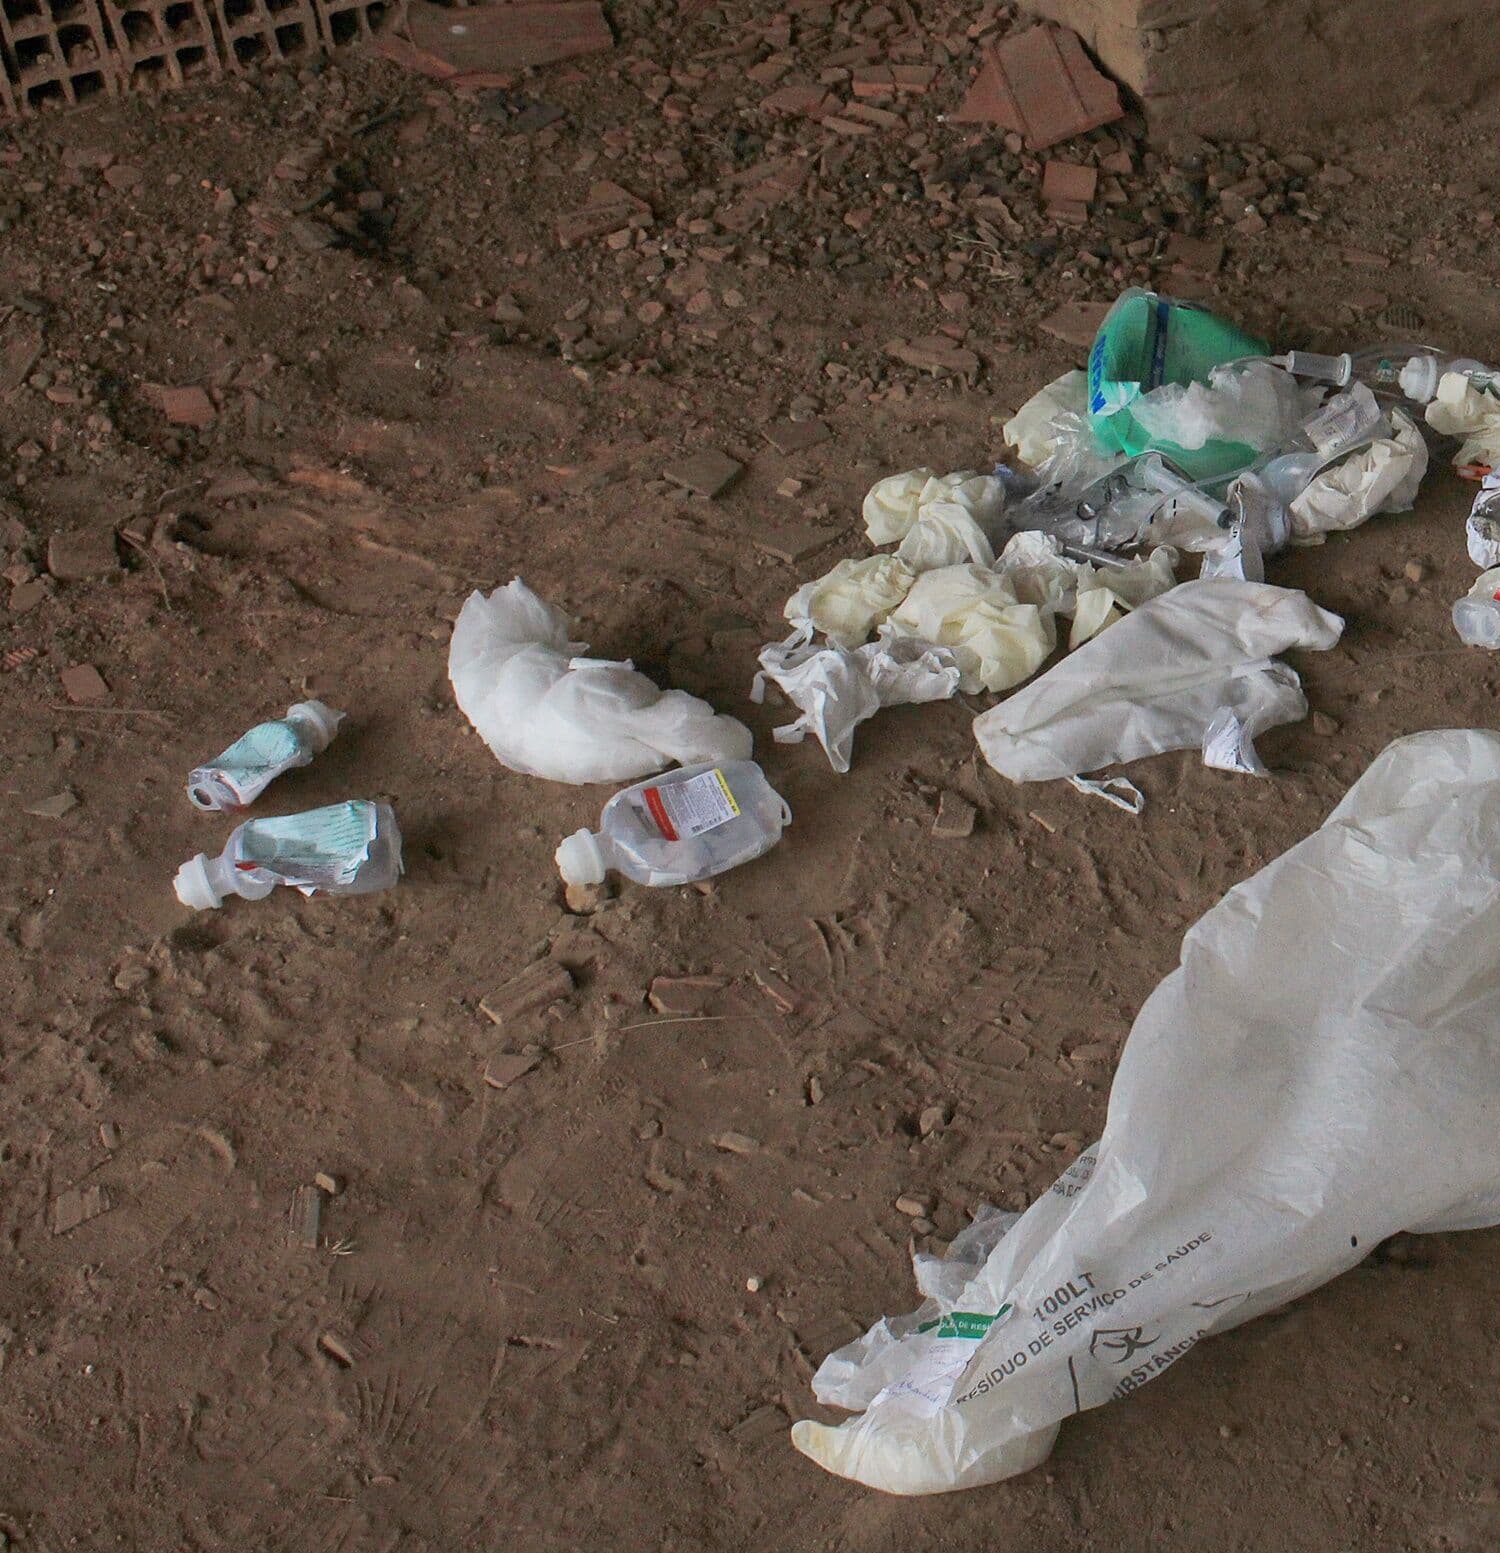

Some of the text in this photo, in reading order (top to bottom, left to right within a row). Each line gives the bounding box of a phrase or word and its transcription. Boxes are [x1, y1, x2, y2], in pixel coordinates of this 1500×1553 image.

[1028, 1331, 1052, 1357] DE
[1053, 1288, 1126, 1335] SERVIÇO
[1128, 1271, 1153, 1289] DE
[1033, 1272, 1098, 1322] 100LT
